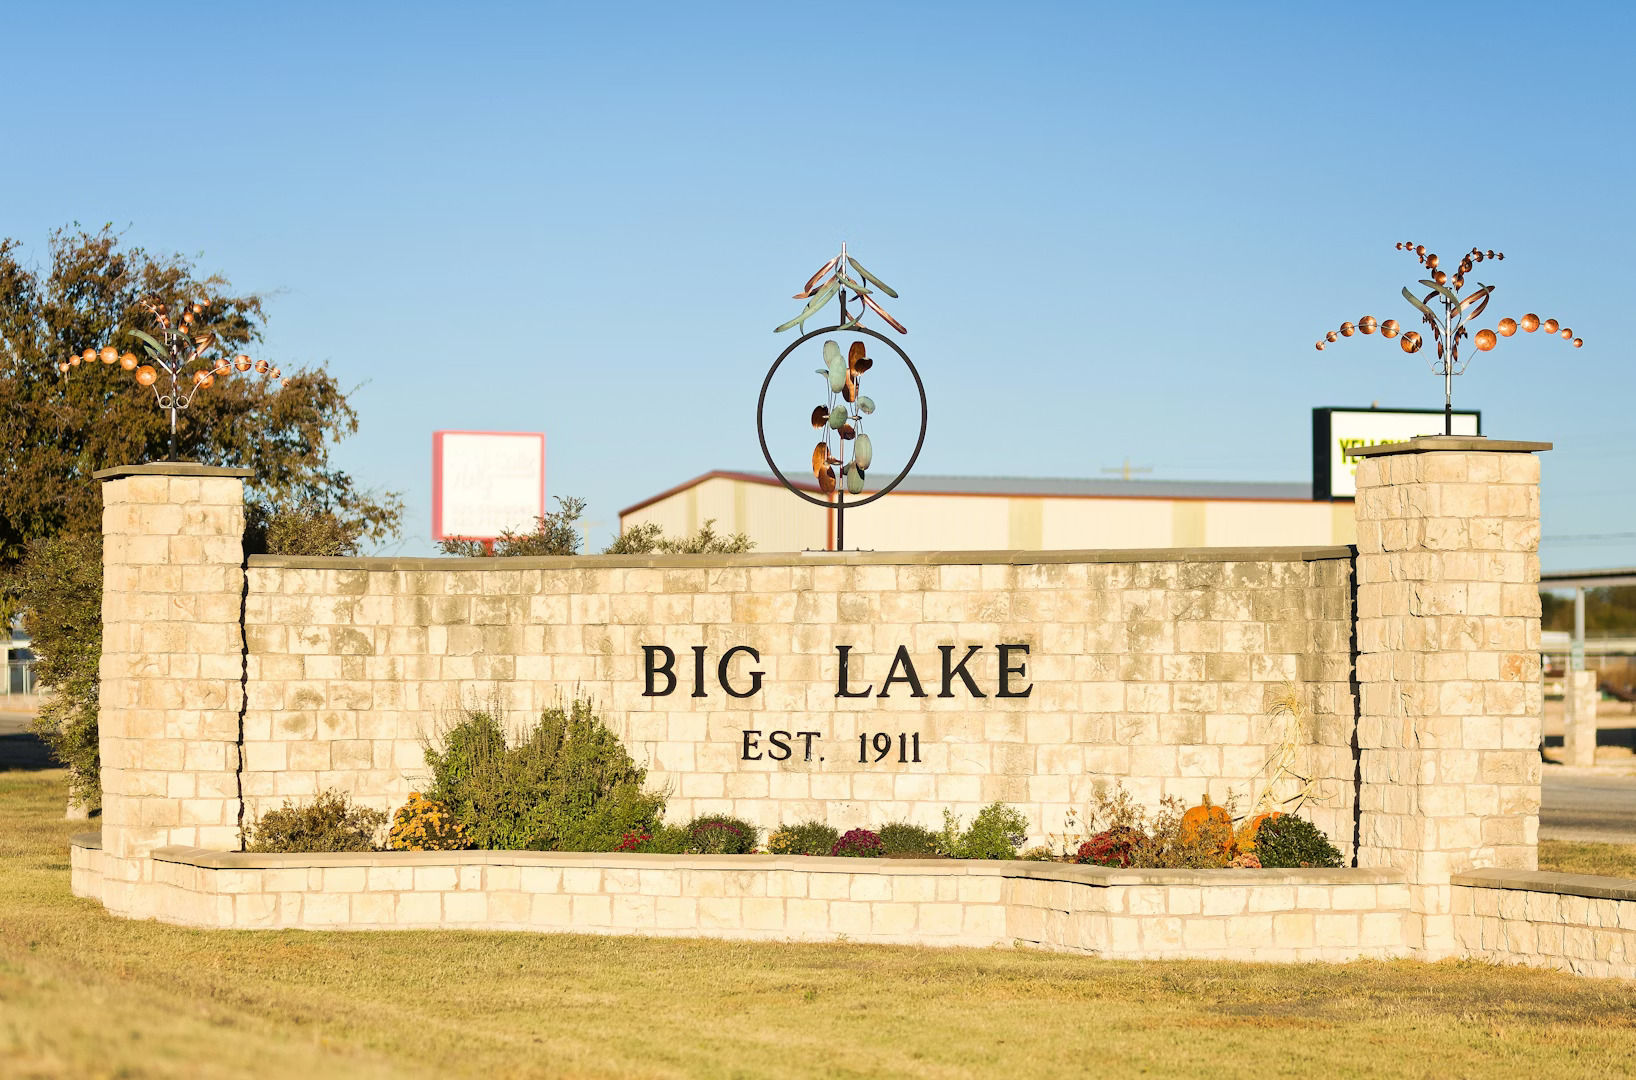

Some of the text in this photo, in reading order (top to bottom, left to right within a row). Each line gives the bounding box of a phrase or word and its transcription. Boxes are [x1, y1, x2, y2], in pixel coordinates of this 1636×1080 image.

[641, 643, 1034, 699] BIG LAKE
[741, 730, 922, 763] EST. 1911
